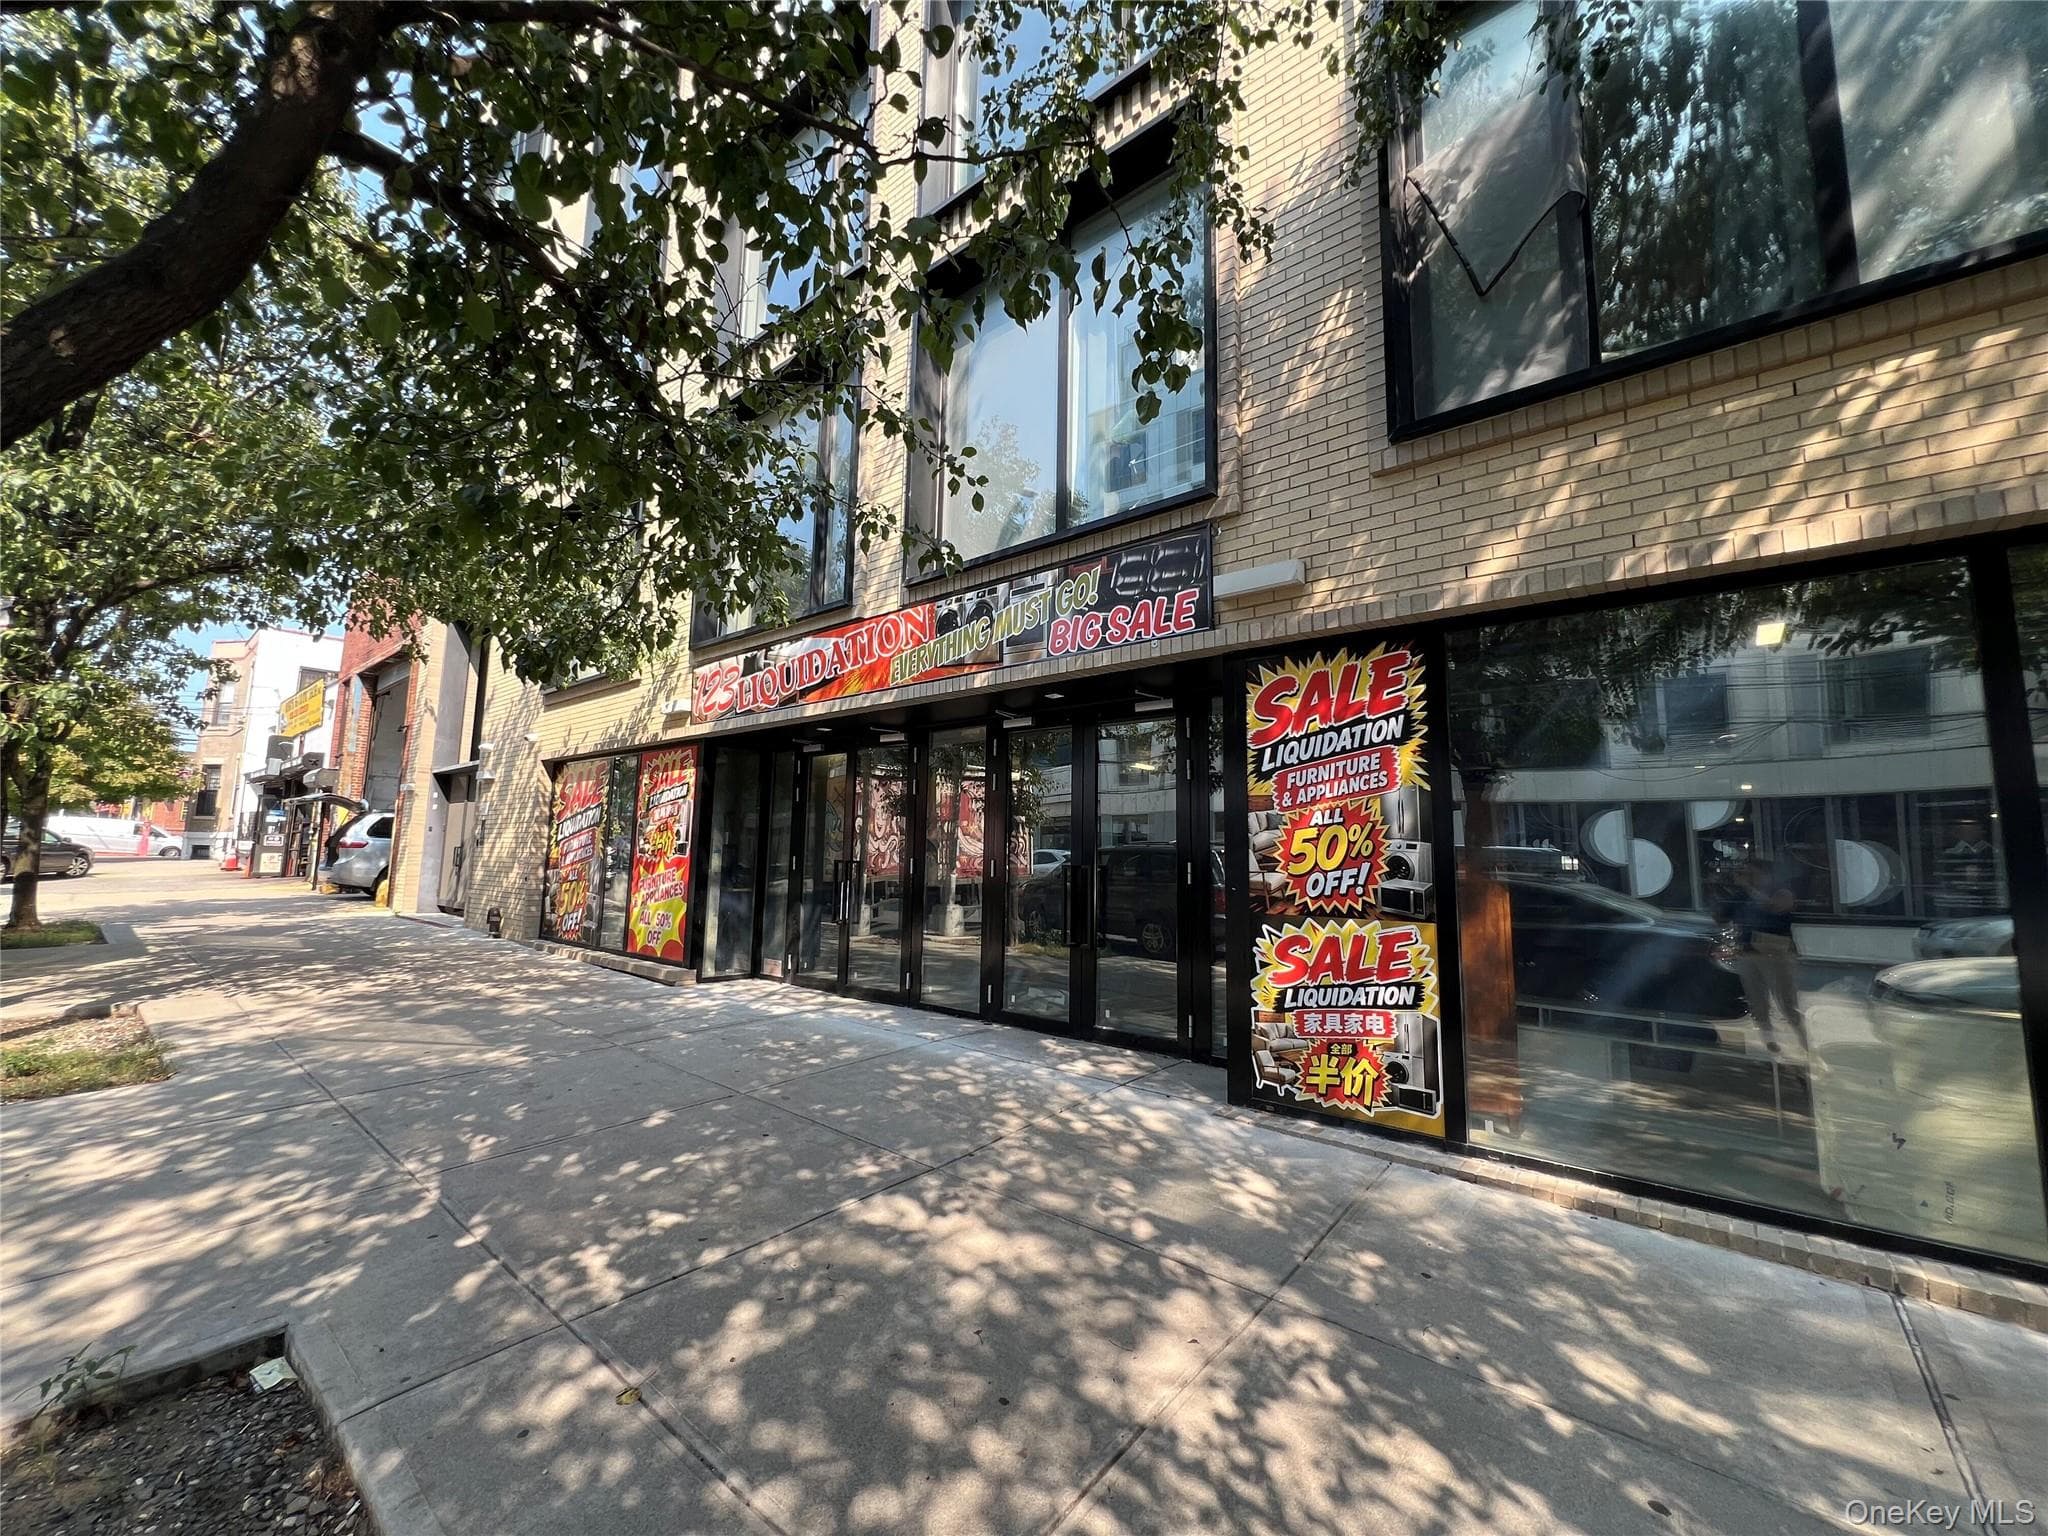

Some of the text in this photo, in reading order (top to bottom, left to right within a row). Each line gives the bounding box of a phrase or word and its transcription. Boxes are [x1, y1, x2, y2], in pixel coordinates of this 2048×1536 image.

[889, 563, 1101, 685] EVERYTHING MUST GO!
[1048, 588, 1199, 656] BIG SALE
[693, 604, 936, 716] 123 LIQUIDATION
[1250, 650, 1412, 747] SALE
[1261, 716, 1404, 772] LIQUIDATION
[1281, 770, 1388, 807] & APPLIANCES
[1286, 752, 1380, 789] FURNITURE
[1310, 809, 1344, 827] ALL
[1287, 823, 1374, 876] 50%
[639, 868, 677, 891] FURNITURE
[640, 880, 684, 907] APPLIANCES
[1305, 861, 1369, 898] OFF!
[639, 911, 673, 929] ALL 50%
[647, 930, 662, 945] OFF
[1268, 929, 1416, 986] SALE
[1284, 985, 1416, 1009] LIQUIDATION
[1303, 1012, 1387, 1036] 家具家电
[1330, 1043, 1353, 1054] 全部
[1306, 1054, 1379, 1106] 半价
